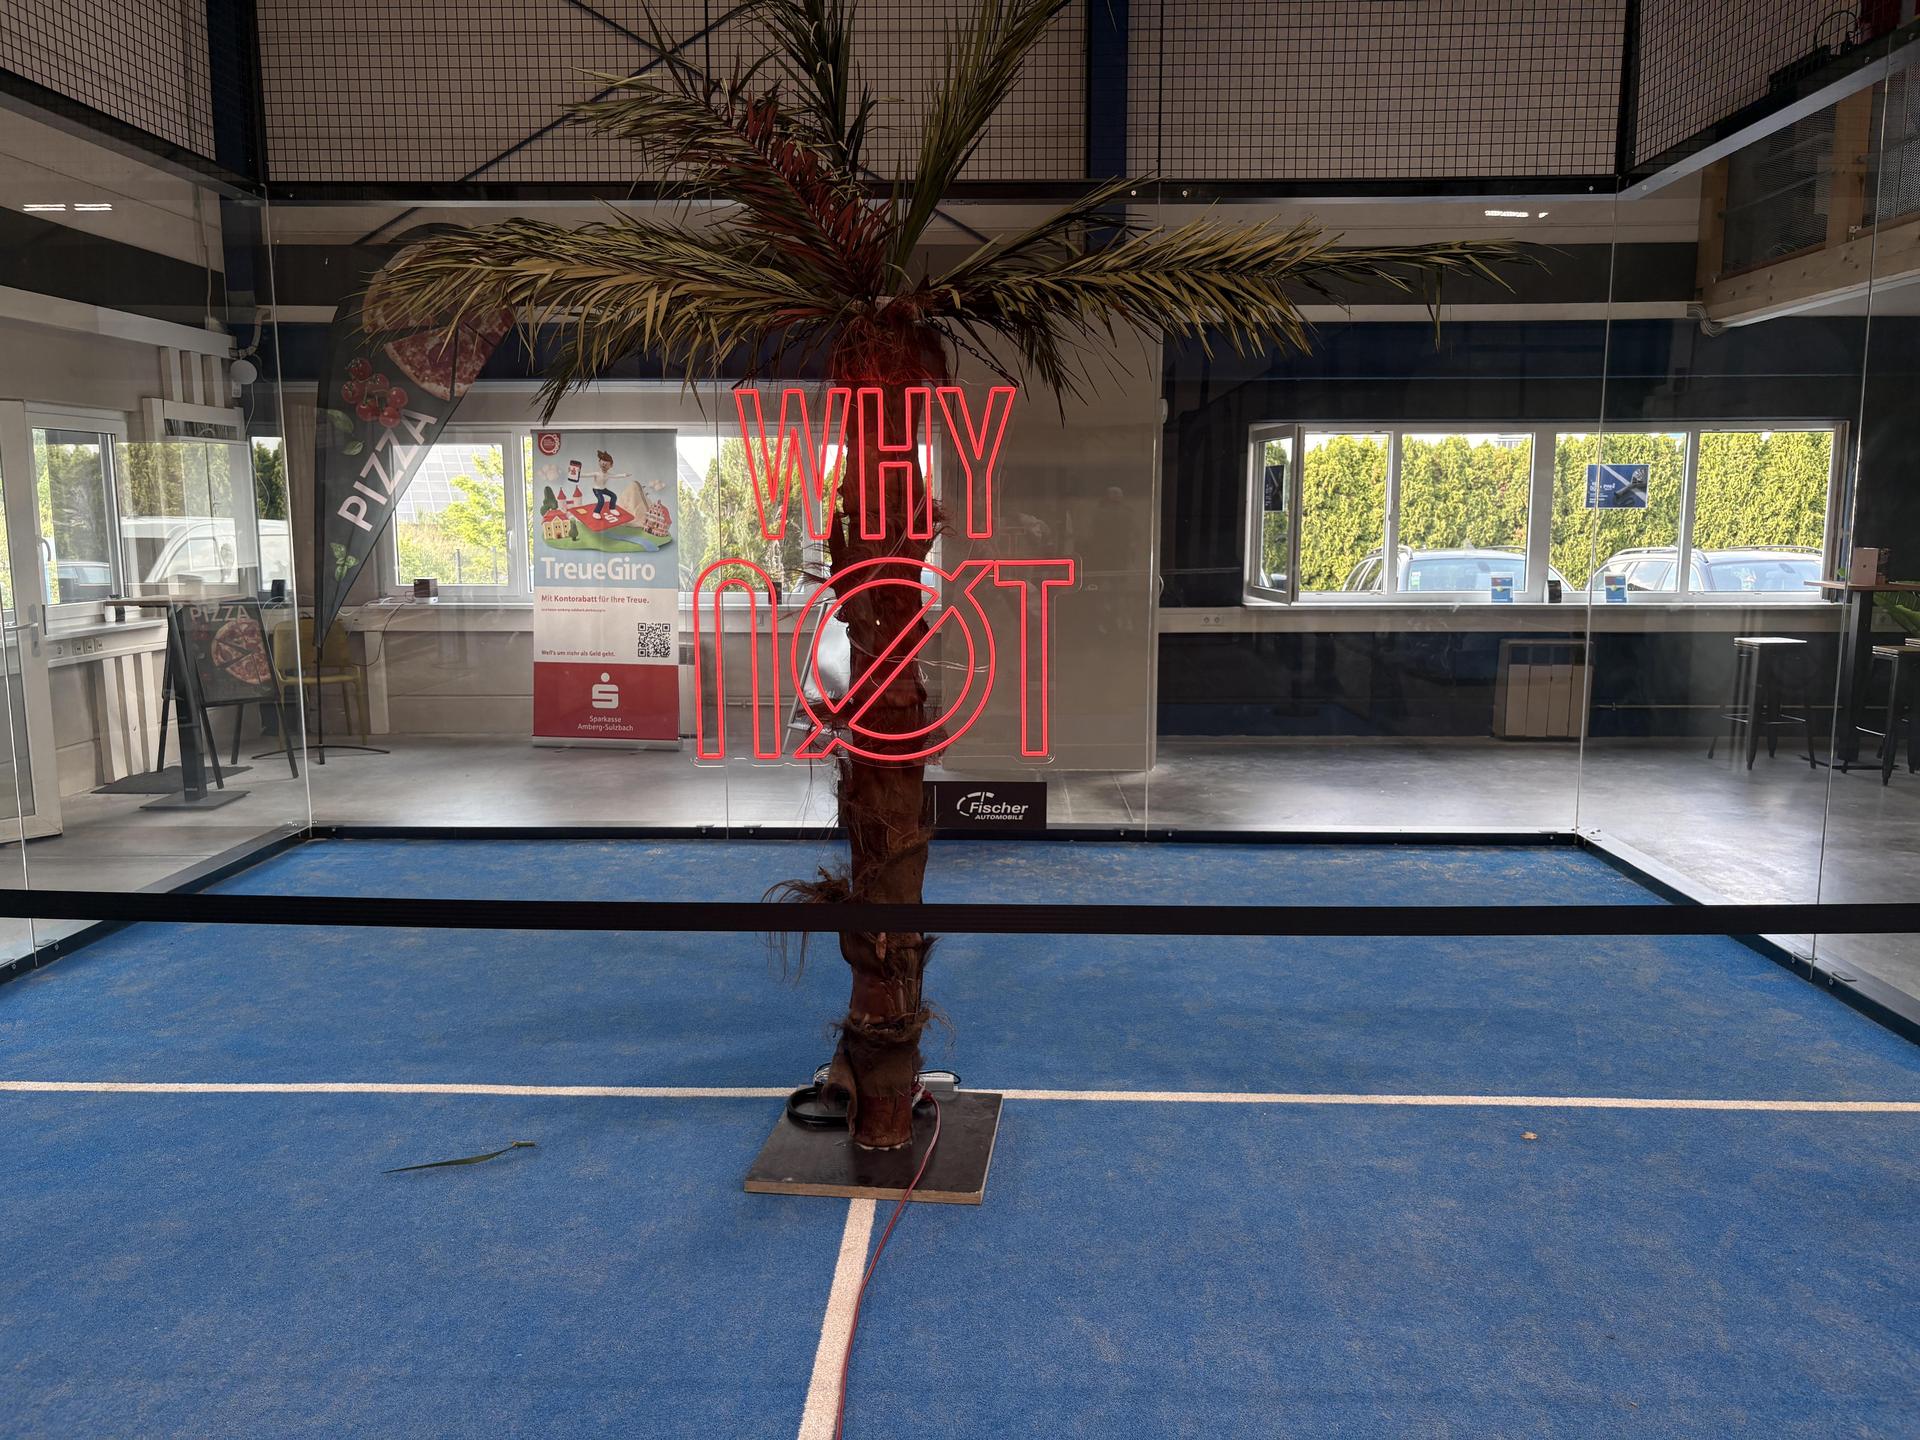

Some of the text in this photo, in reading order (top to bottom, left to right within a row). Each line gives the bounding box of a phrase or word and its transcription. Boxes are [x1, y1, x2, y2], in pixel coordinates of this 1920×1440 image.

[337, 409, 438, 532] PIZZA
[733, 387, 1017, 541] WHY
[540, 556, 656, 581] TreueGiro
[541, 594, 650, 604] Mit Kontorabatt für Ihre Treue.
[189, 605, 252, 622] PIZZA
[589, 715, 622, 723] Sparkasse
[577, 723, 634, 732] Amberg-Sulzbach
[969, 801, 1029, 814] Fischer
